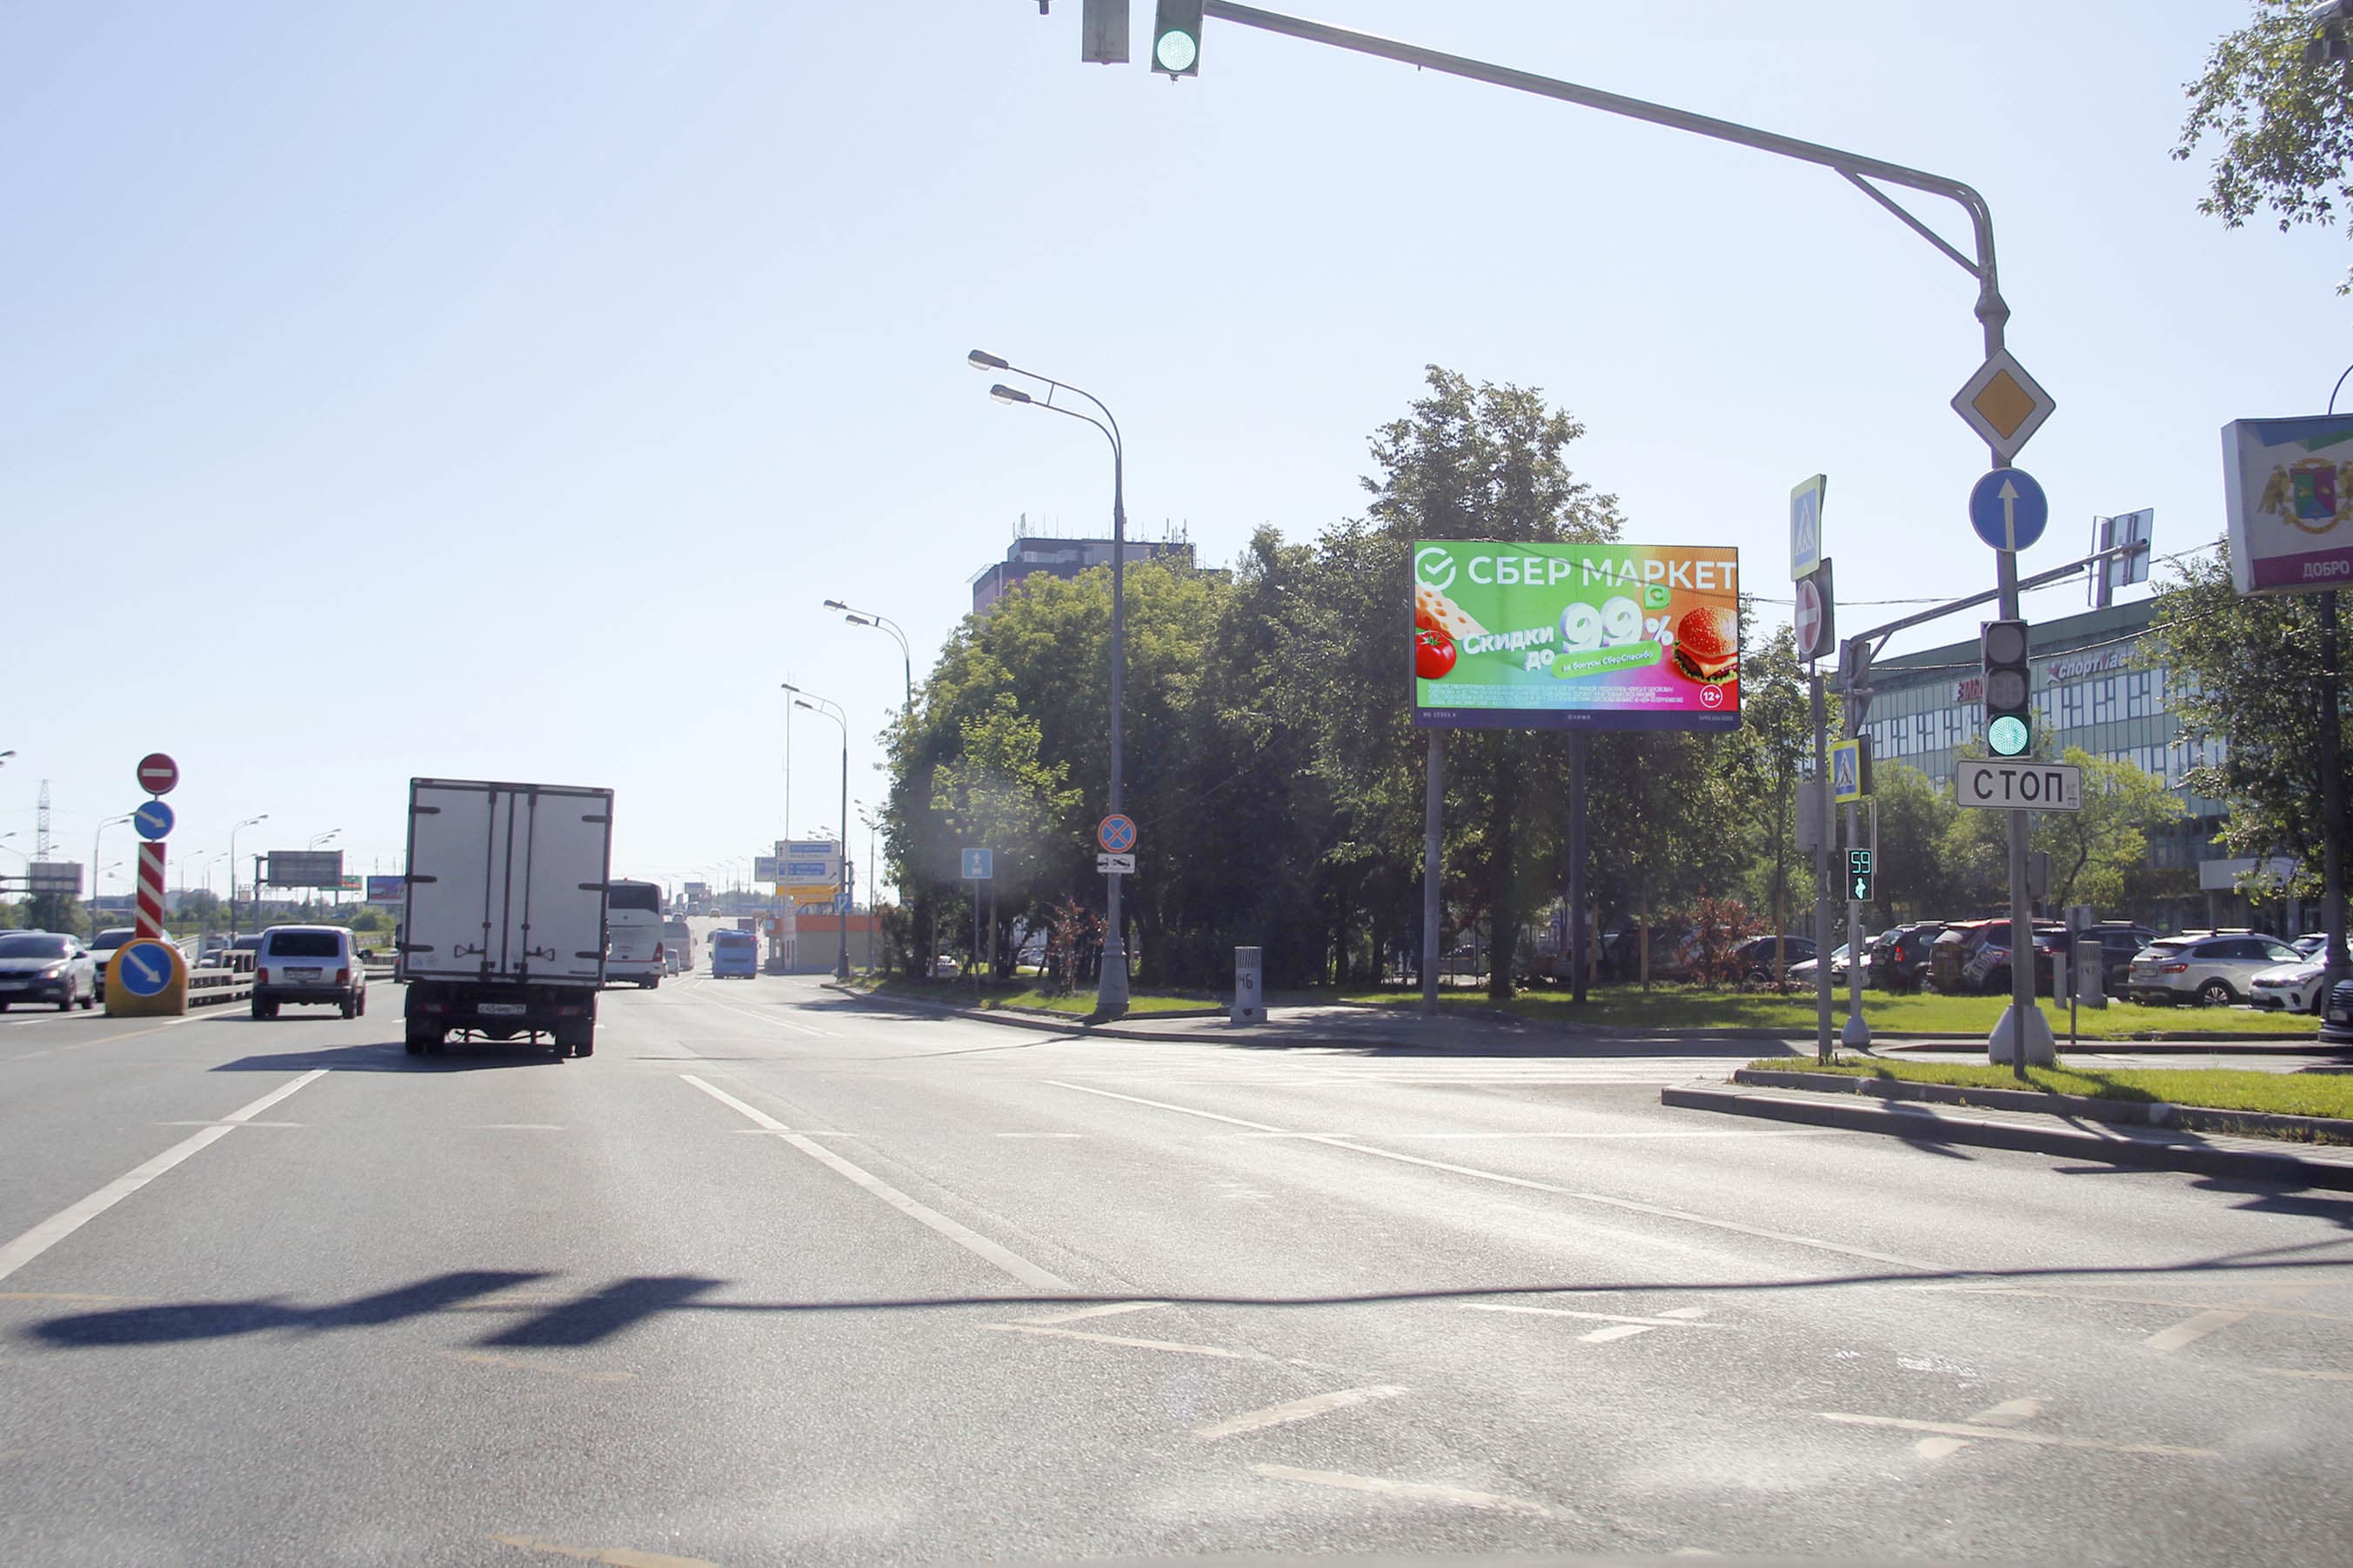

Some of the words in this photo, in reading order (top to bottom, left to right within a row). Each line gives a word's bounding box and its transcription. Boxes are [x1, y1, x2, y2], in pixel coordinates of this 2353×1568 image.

[1468, 556, 1571, 585] СБЕР
[1582, 558, 1737, 590] МАРКЕТ
[2303, 560, 2350, 579] ДОБРО
[1462, 626, 1554, 655] Скидки
[1525, 649, 1555, 671] до
[1573, 660, 1601, 670] бонусы
[1601, 651, 1653, 665] СберСпасибо
[1702, 691, 1721, 701] 12+
[1973, 769, 2062, 802] СТОП
[1850, 851, 1871, 874] 59
